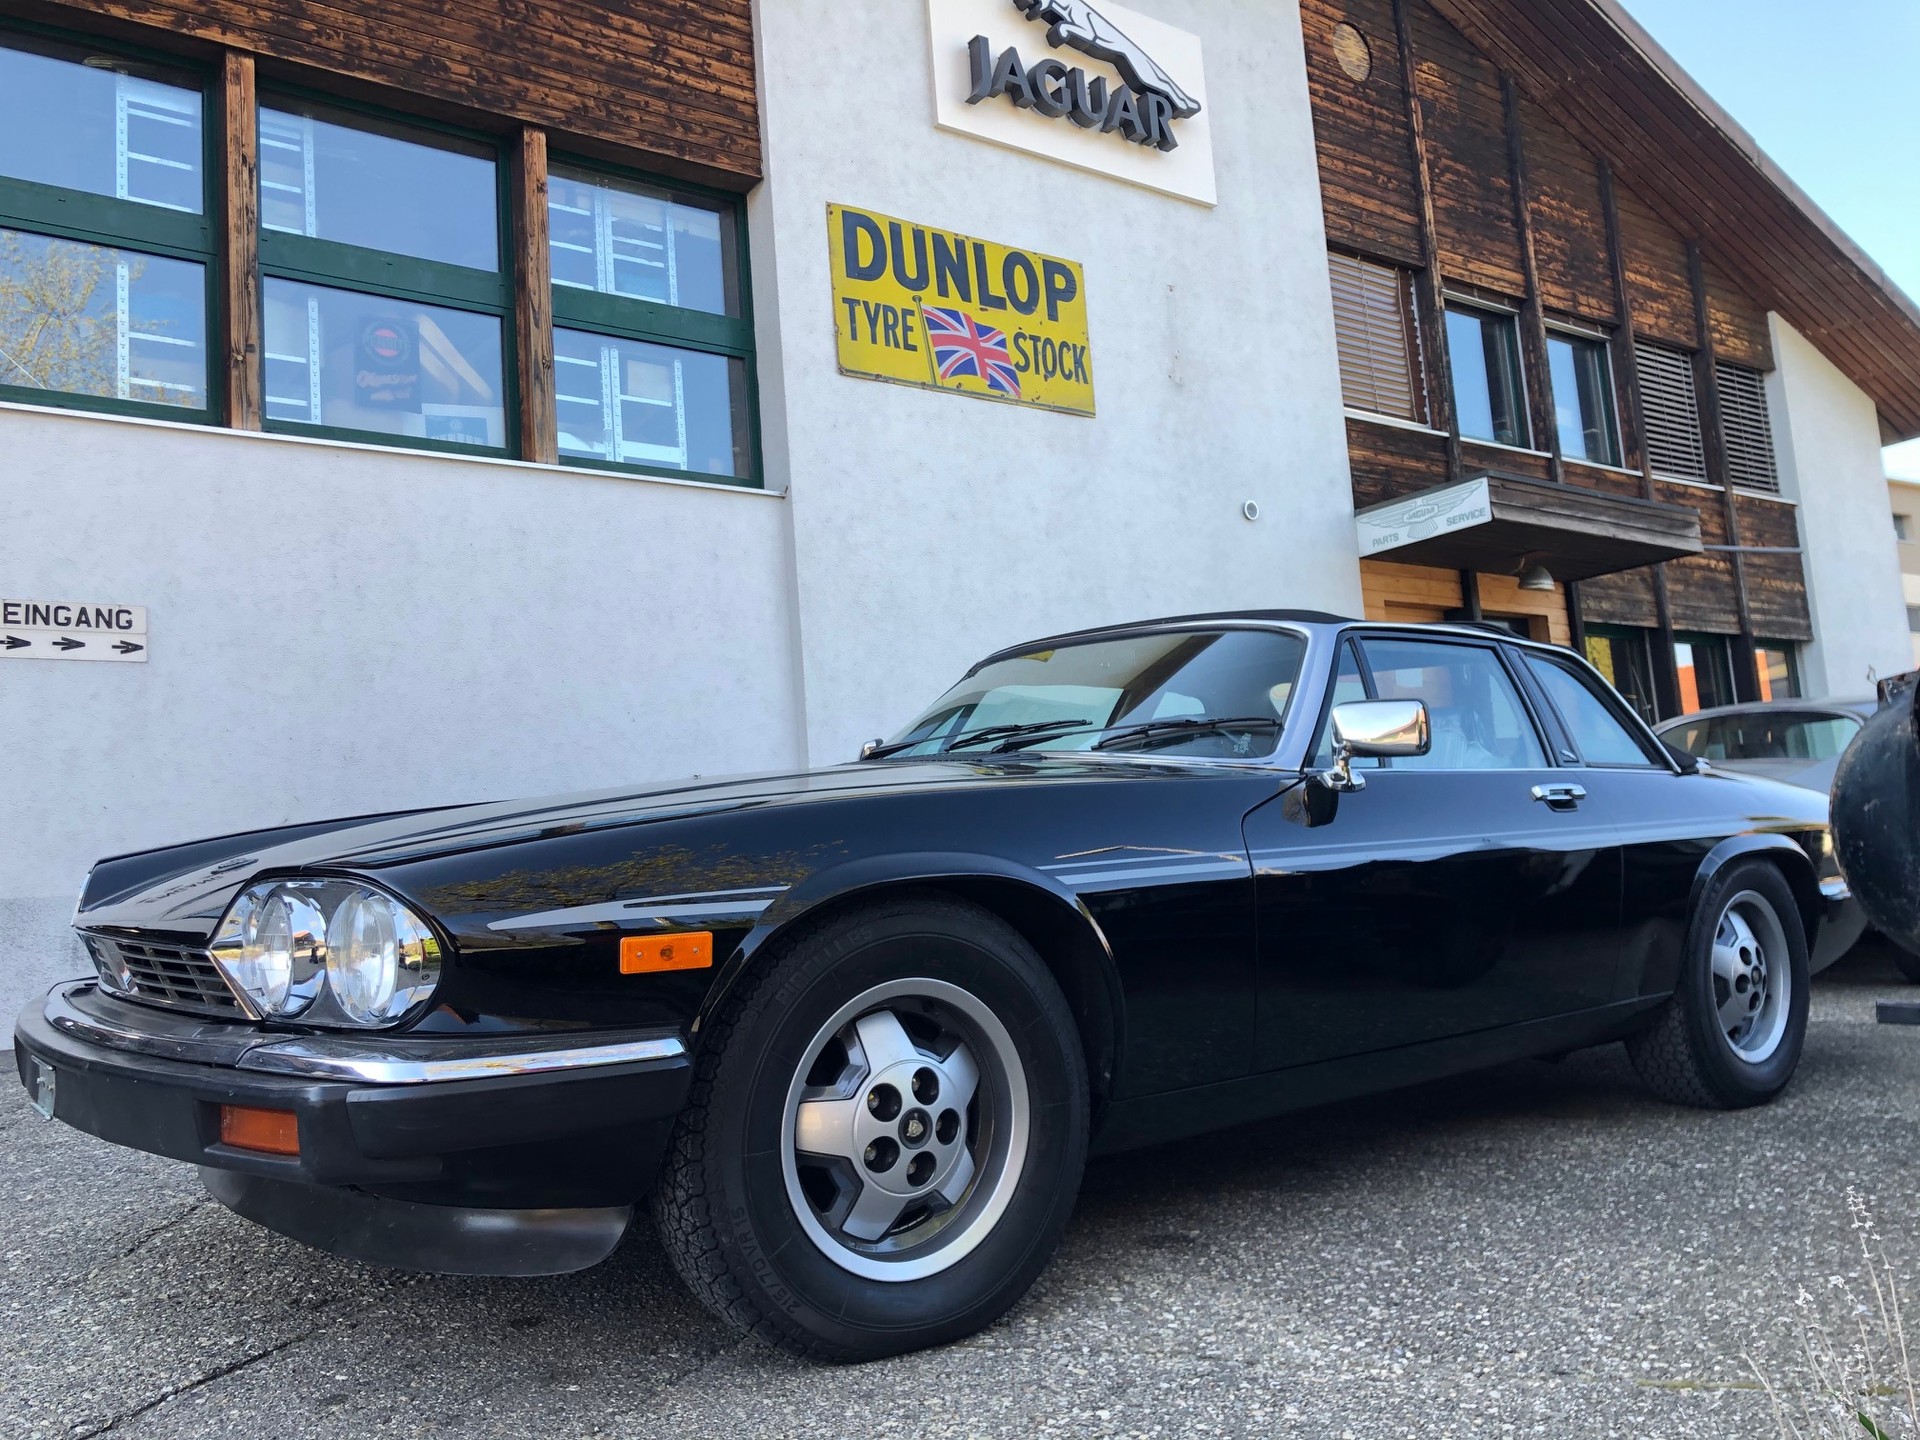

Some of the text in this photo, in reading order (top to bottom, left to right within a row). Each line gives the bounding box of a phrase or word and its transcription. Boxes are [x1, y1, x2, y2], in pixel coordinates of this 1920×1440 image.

[965, 34, 1179, 152] JAGUAR
[841, 210, 1077, 322] DUNLOP
[841, 297, 918, 352] TYRE
[1014, 331, 1089, 385] STOCK
[1372, 532, 1400, 548] PARTS
[1446, 507, 1486, 526] SERVICE
[3, 602, 133, 630] EINGANG
[732, 1206, 802, 1314] 215/70 VR 15
